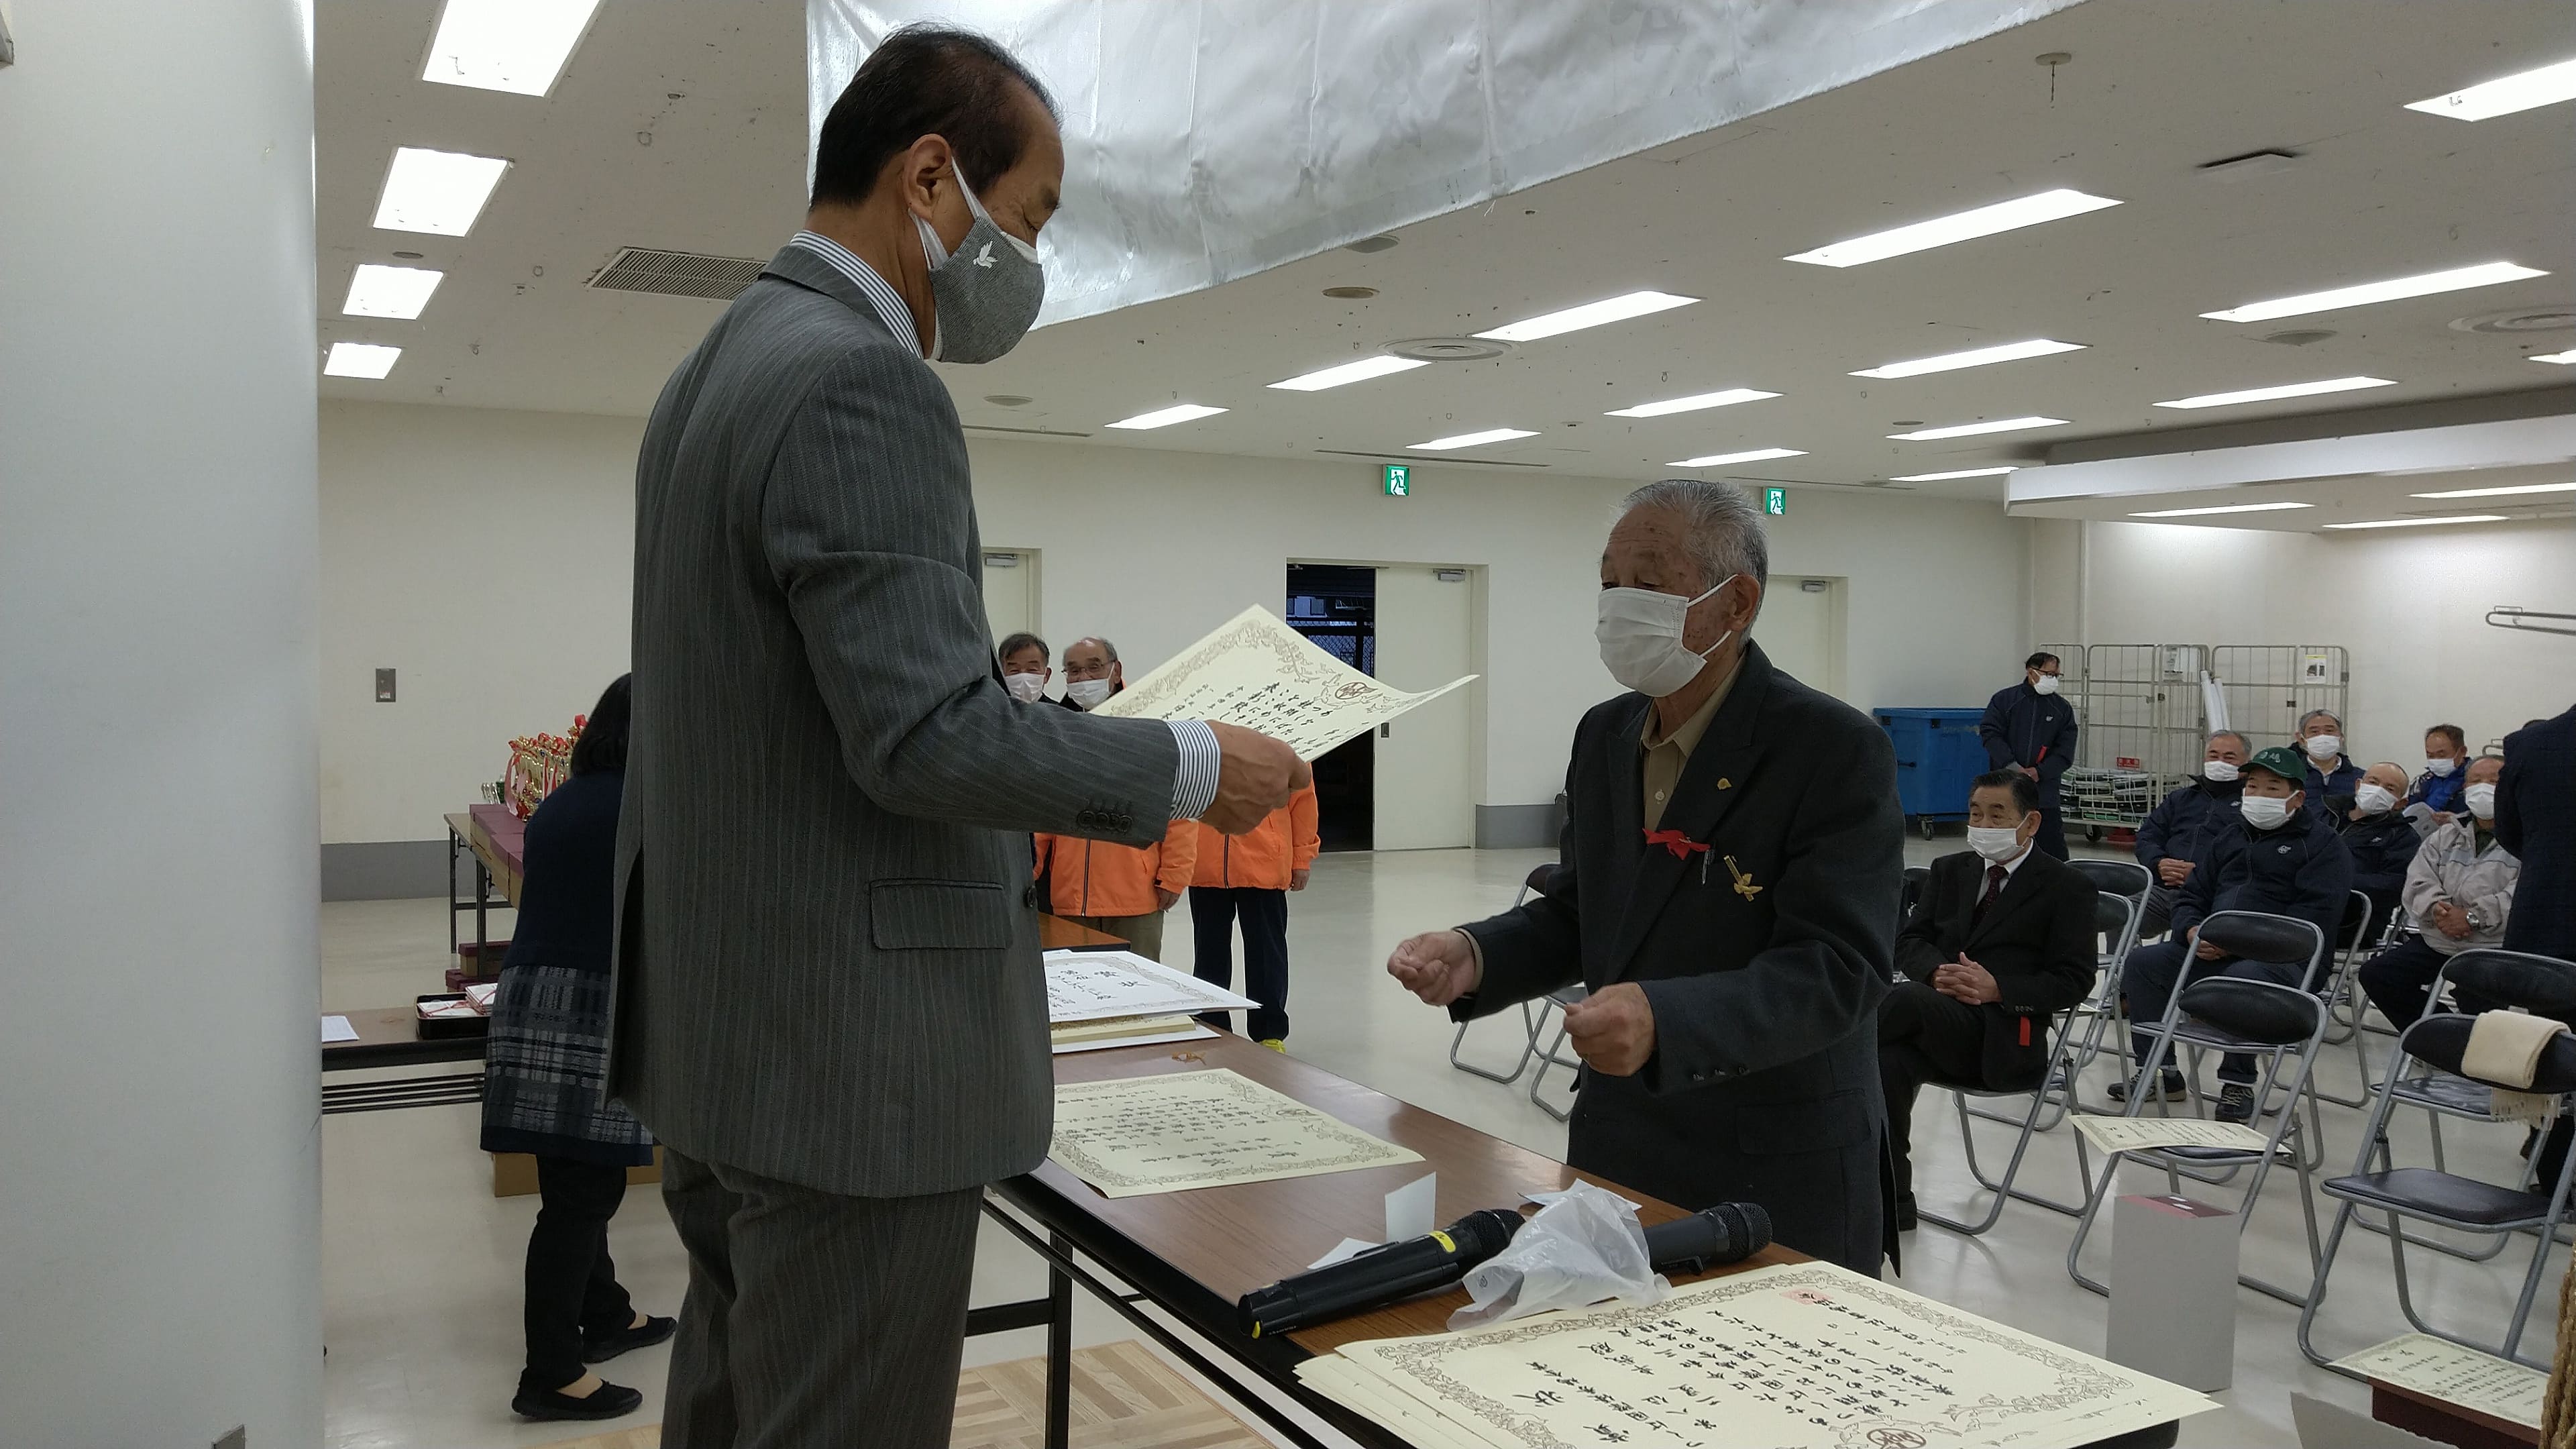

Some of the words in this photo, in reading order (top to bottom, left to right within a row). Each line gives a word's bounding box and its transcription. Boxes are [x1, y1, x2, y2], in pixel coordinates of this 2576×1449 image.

[1608, 1326, 1829, 1426] あなたは令和三年度
[1631, 1322, 1855, 1419] つくば国際鳩舎の各種
[1706, 1310, 1930, 1401] ここにその栄誉をたたえ
[1745, 1340, 1909, 1407] を収められました
[1817, 1339, 1955, 1395] 表彰致します
[1641, 1395, 1717, 1430] 第八位
